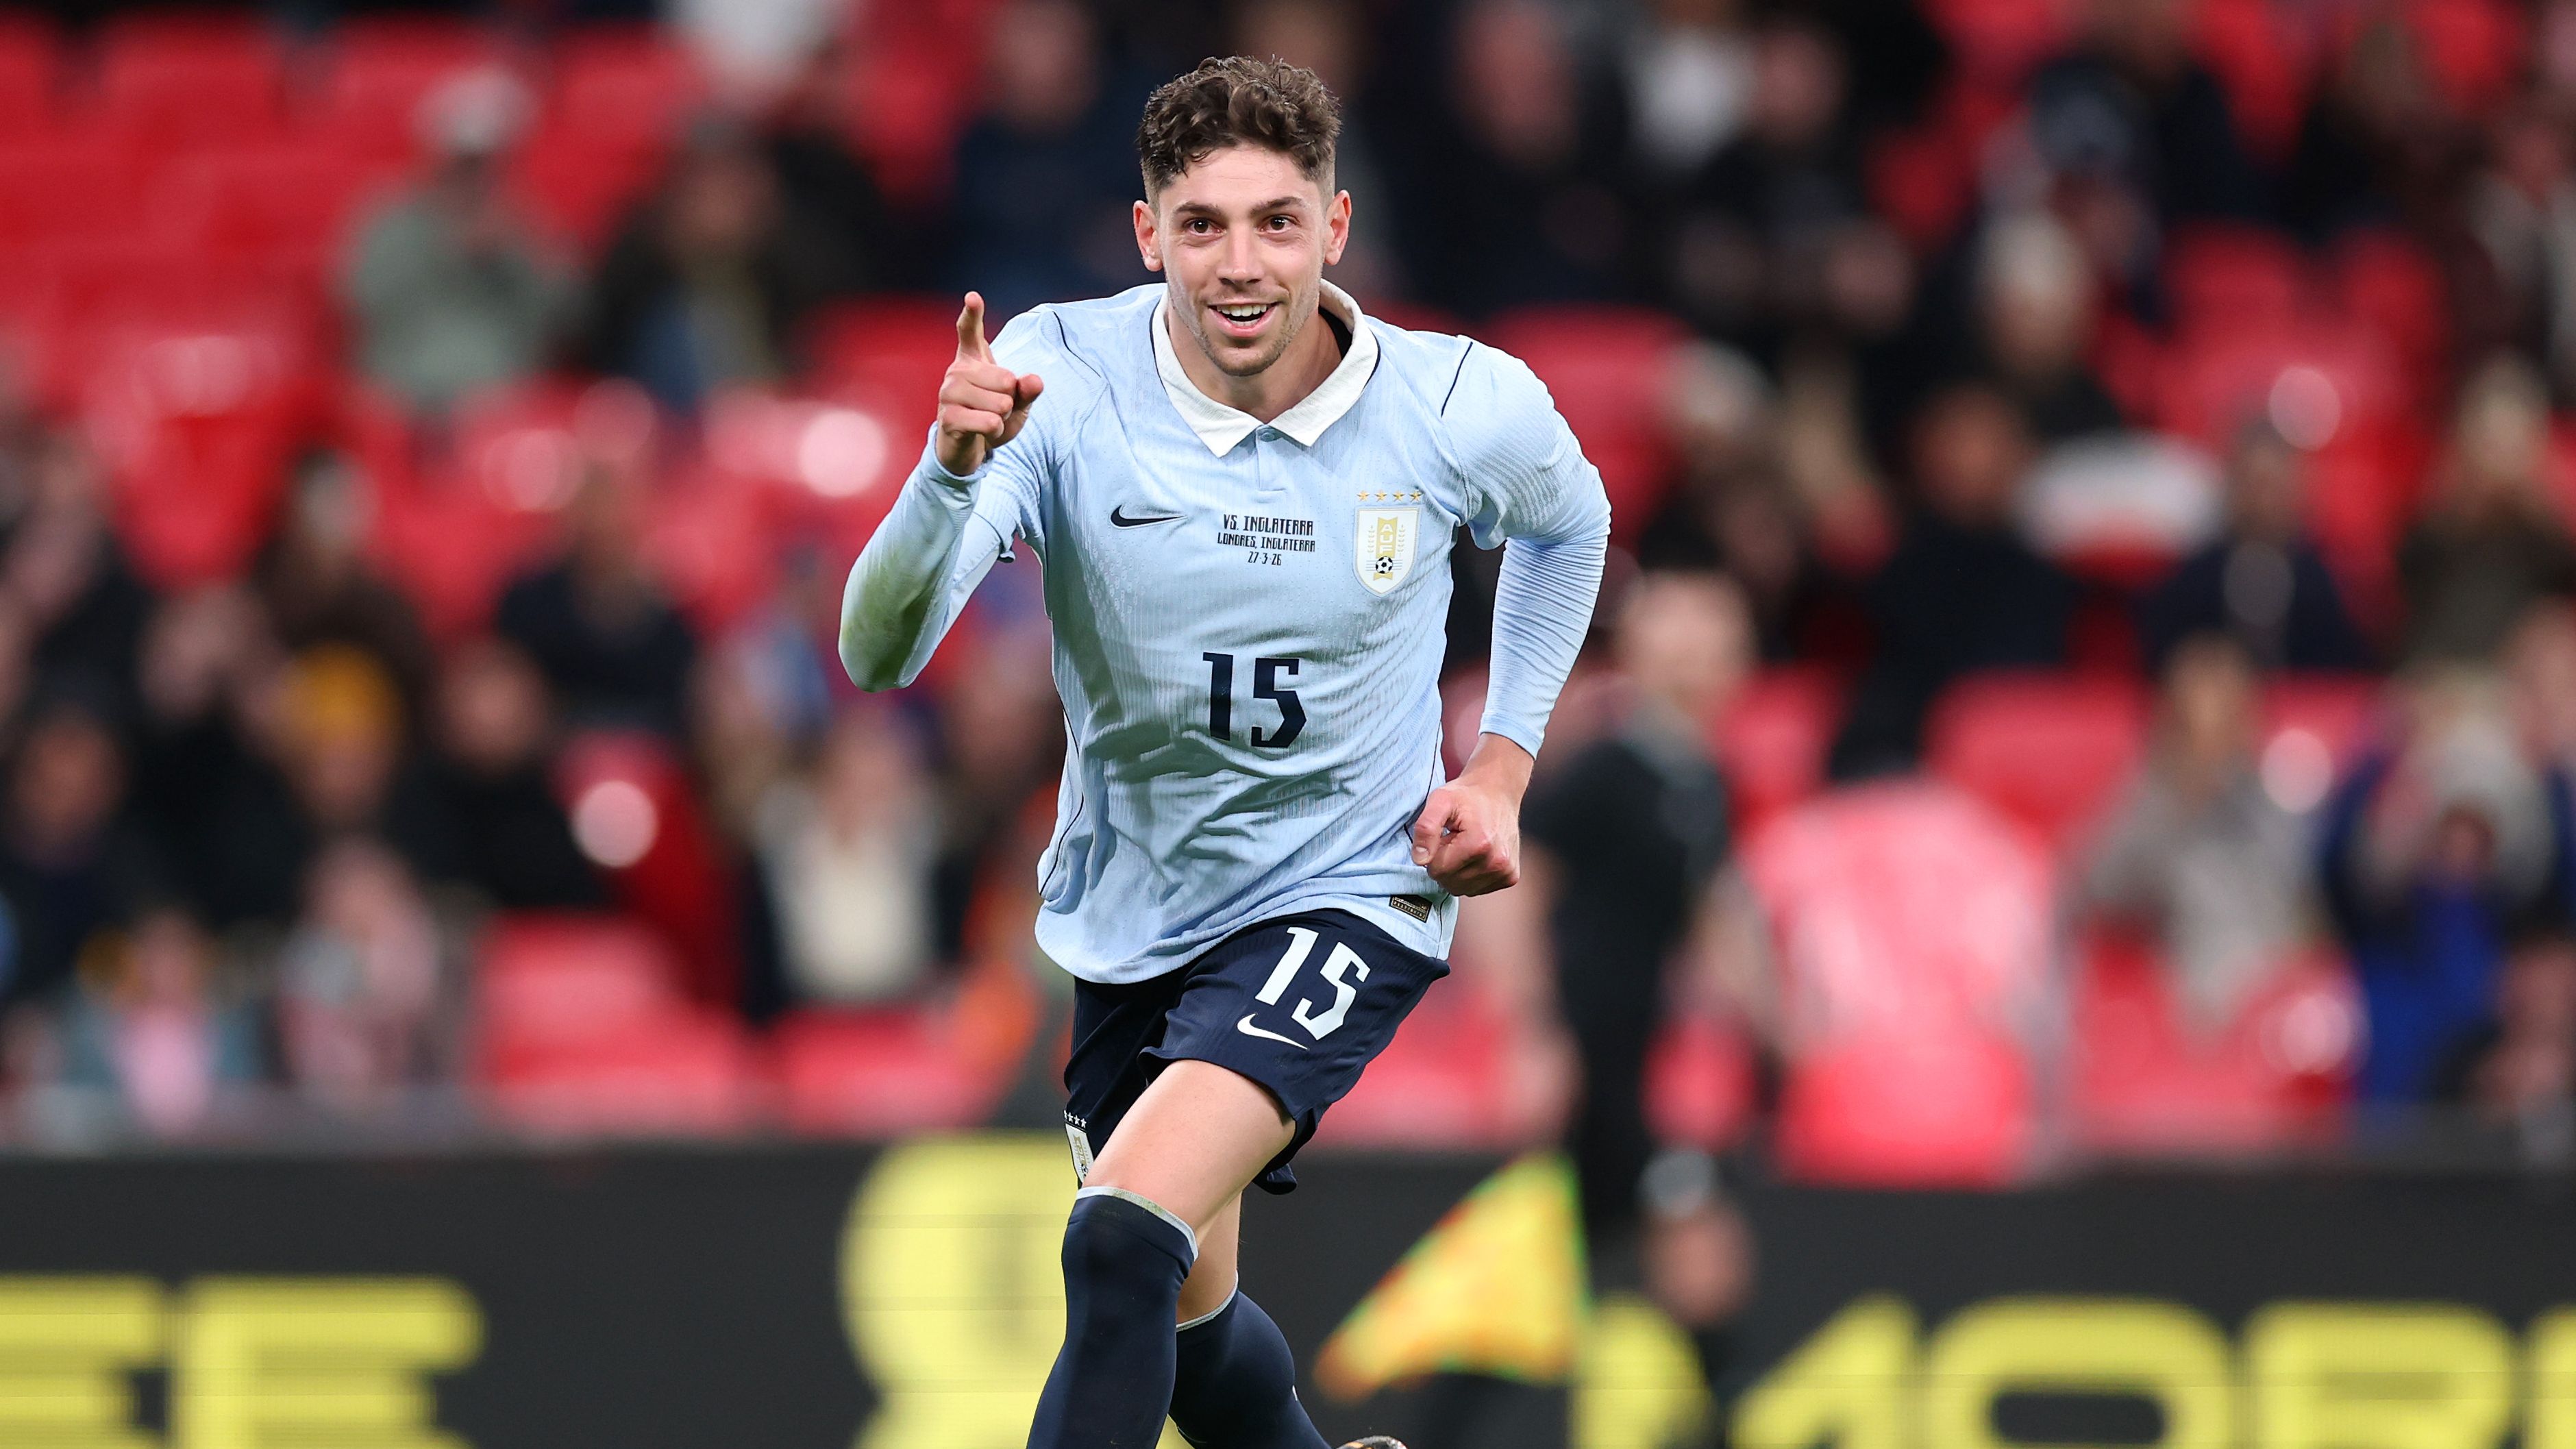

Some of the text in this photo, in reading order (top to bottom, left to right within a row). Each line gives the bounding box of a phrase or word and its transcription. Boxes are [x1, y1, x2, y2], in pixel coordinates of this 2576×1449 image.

[1217, 532, 1315, 552] LONDRES, INGLATERRA
[1224, 514, 1313, 536] VS. INGLATERRA
[1379, 523, 1394, 554] AUF
[1202, 652, 1307, 748] 15
[1254, 926, 1371, 1041] 15
[1570, 1293, 2576, 1449] MOR
